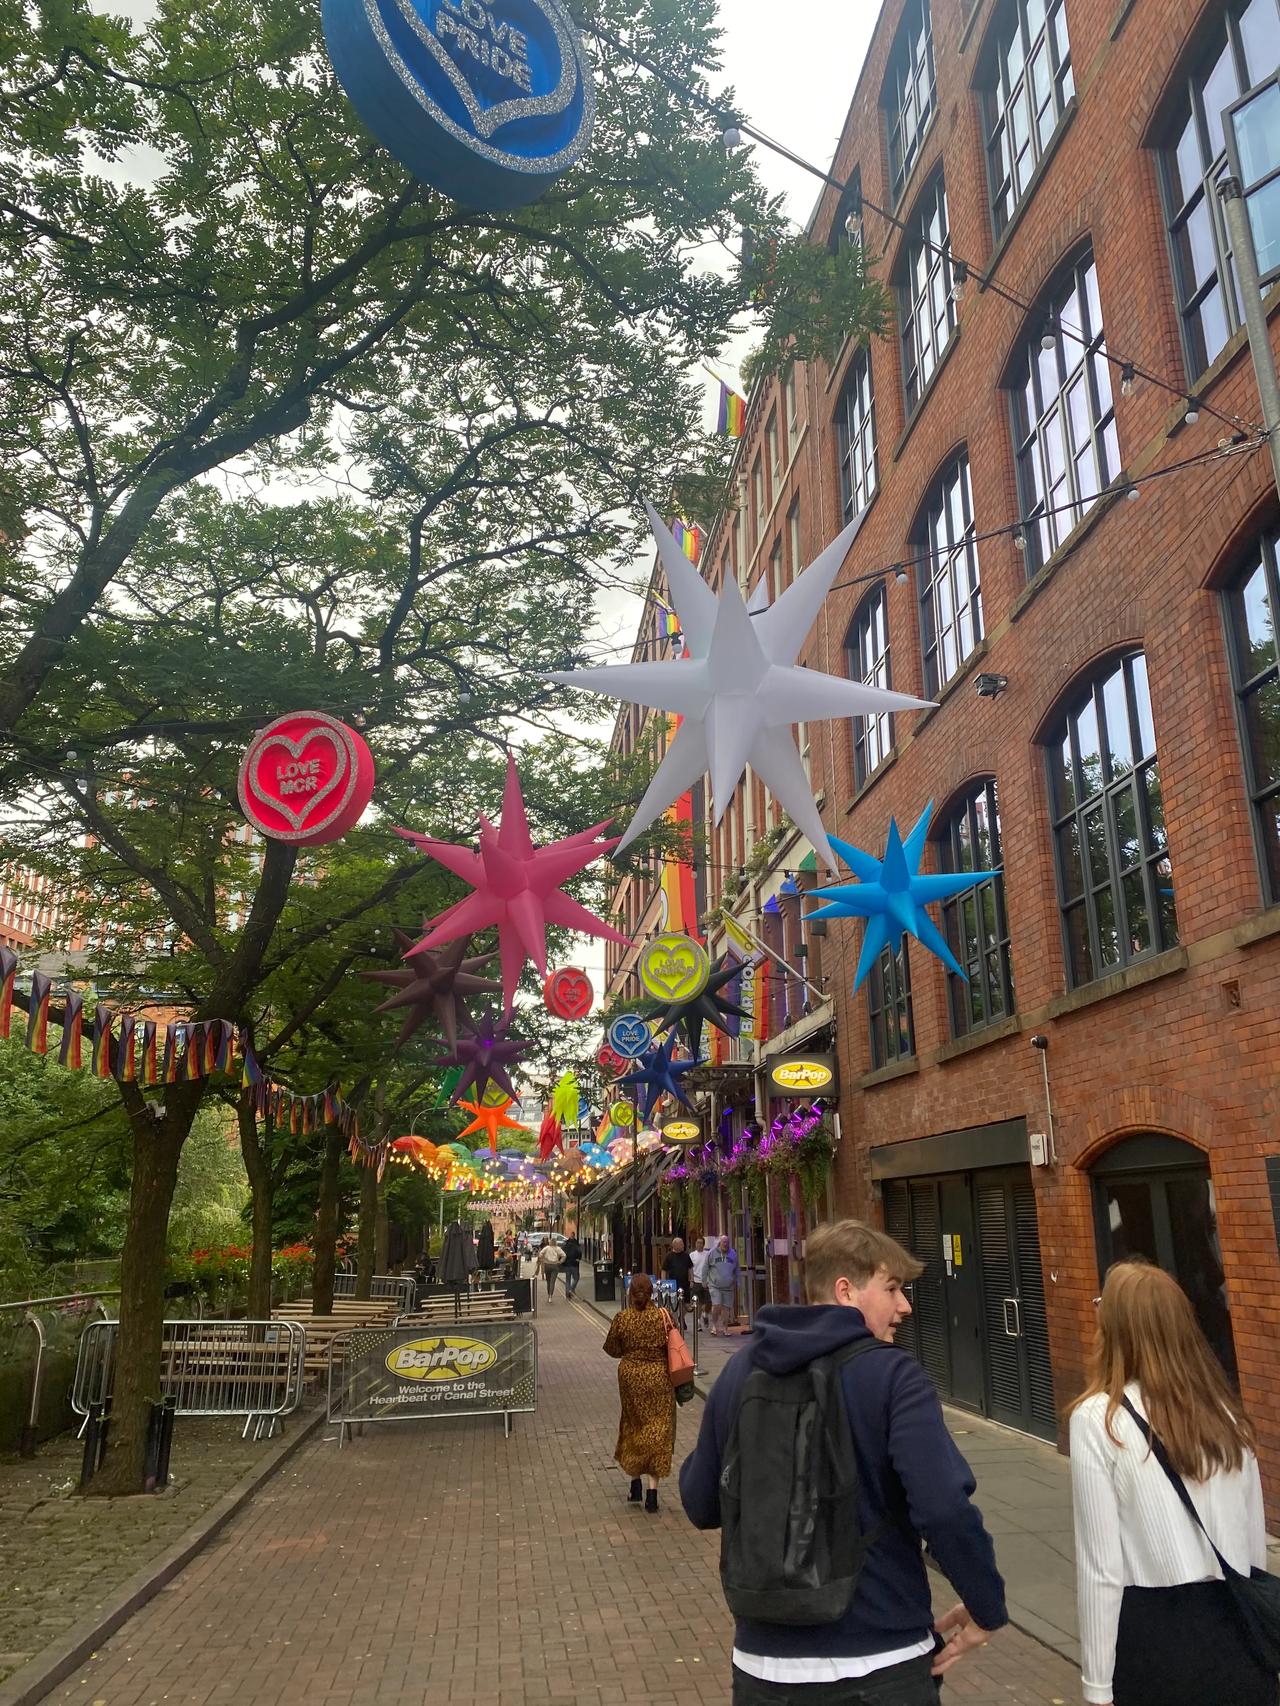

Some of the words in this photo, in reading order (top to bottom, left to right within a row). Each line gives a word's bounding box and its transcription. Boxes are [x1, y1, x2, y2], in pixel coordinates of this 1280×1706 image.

[436, 10, 533, 93] PRIDE
[276, 758, 321, 780] LOVE
[280, 776, 318, 795] MCR
[779, 1069, 827, 1083] BarPop
[395, 1347, 490, 1369] BarPop
[369, 1394, 427, 1405] Heartbeat
[430, 1392, 442, 1401] of
[444, 1390, 477, 1401] Canal
[479, 1387, 515, 1398] Street
[399, 1385, 450, 1394] Welcome
[453, 1382, 465, 1391] to
[467, 1381, 486, 1390] the
